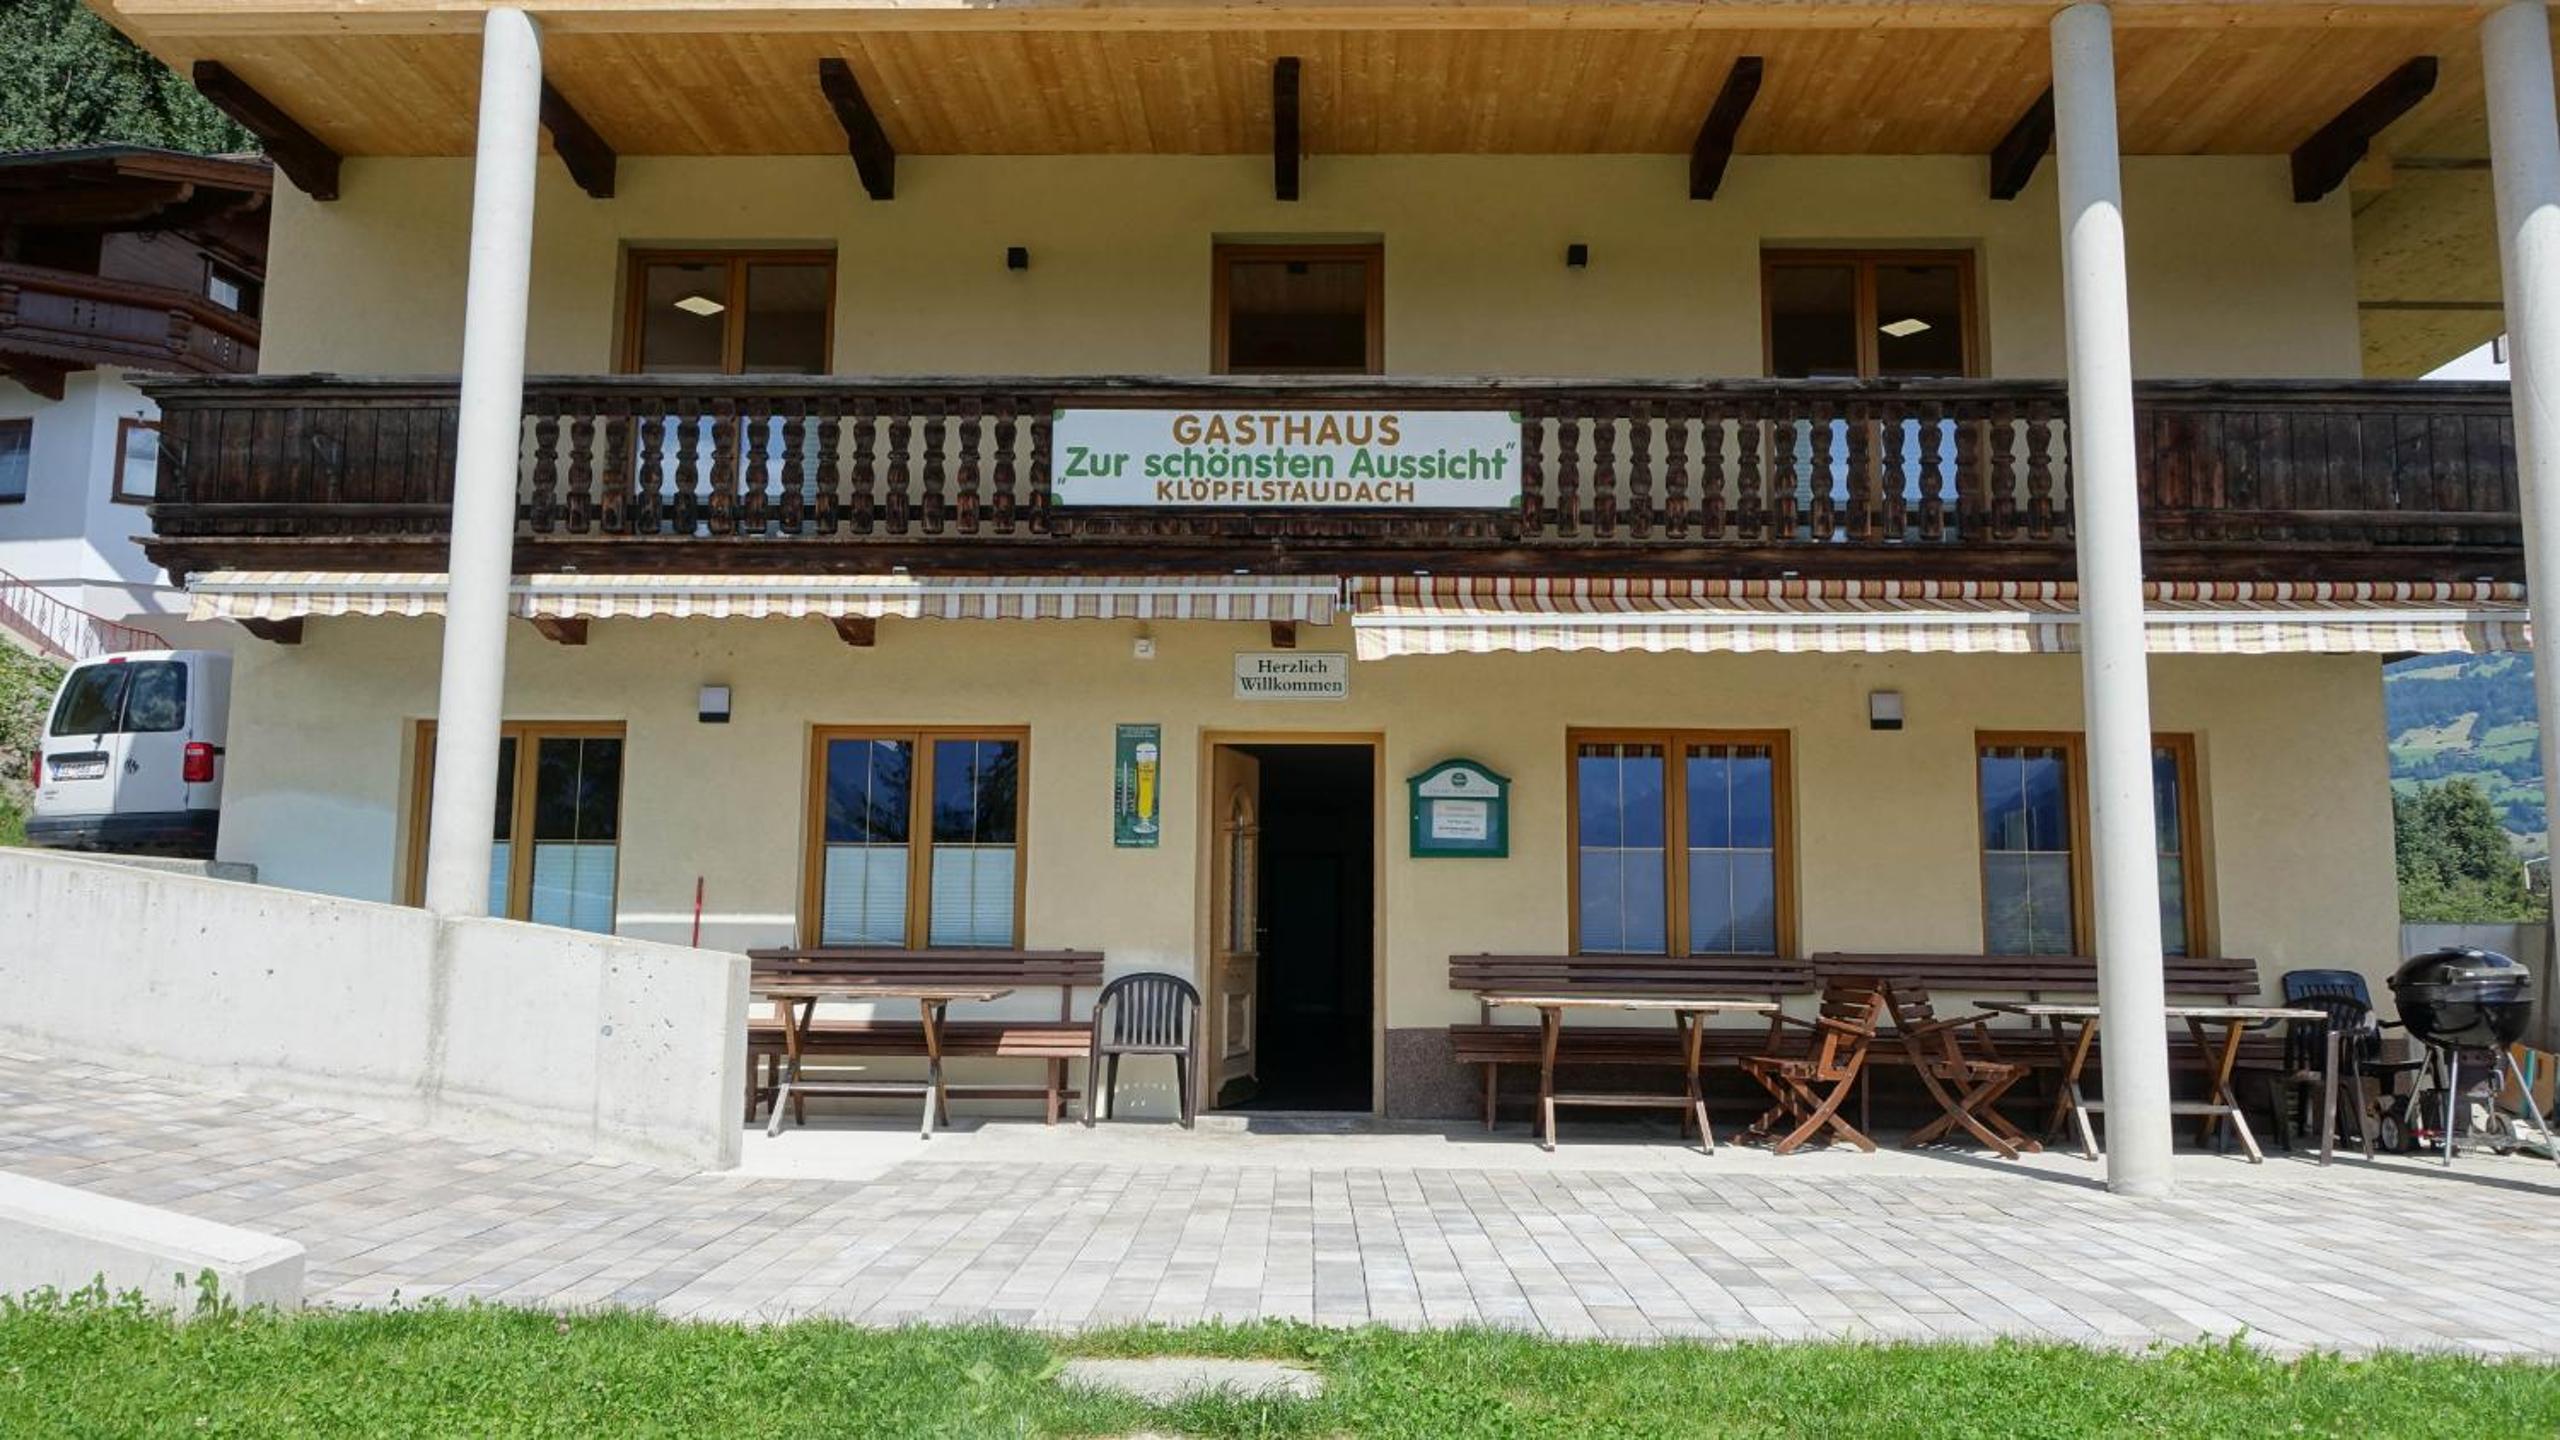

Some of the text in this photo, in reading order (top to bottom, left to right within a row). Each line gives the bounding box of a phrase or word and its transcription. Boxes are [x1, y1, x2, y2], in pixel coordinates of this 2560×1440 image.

[1172, 414, 1400, 446] GASTHAUS
[1144, 447, 1334, 479] schönsten
[1156, 477, 1415, 503] KLÖPFLSTAUDACH
[1258, 659, 1328, 673] Herzlich
[1241, 676, 1343, 692] Willkommen
